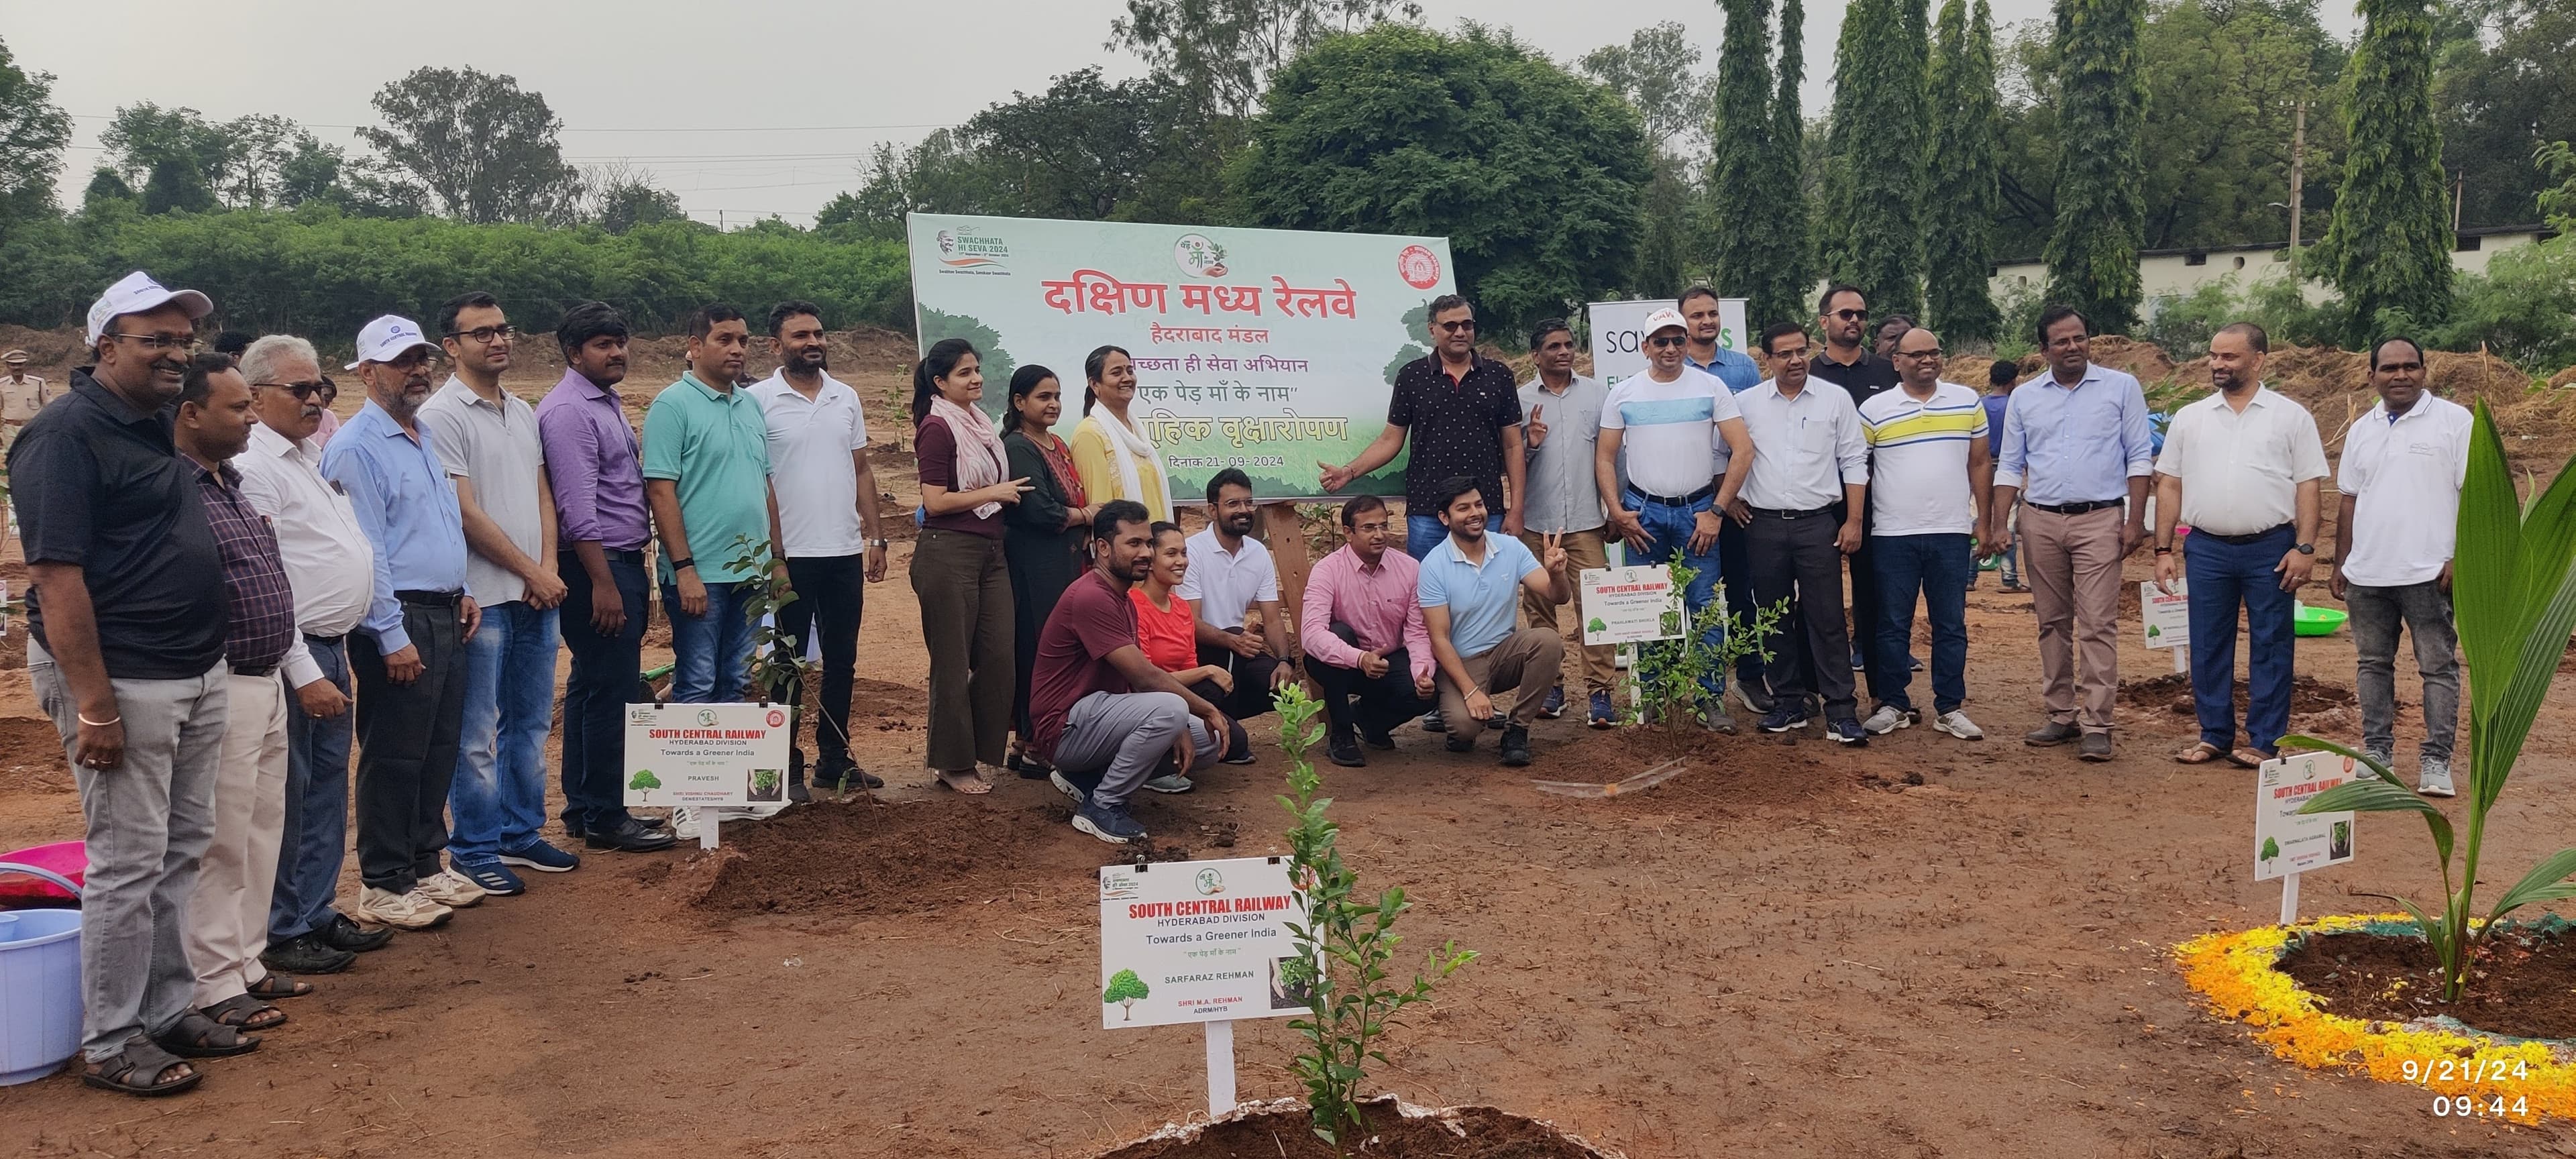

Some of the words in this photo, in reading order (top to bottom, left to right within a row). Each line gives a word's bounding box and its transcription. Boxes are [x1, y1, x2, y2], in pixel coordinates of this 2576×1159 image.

[957, 236, 1004, 245] SWACHHATA
[1040, 269, 1169, 316] दक्षिण
[1179, 284, 1263, 317] मध्य
[1271, 276, 1357, 319] रेलवे
[1150, 322, 1222, 345] हैदराबाद
[1227, 325, 1269, 344] मंडल
[1184, 353, 1201, 374] ही
[1205, 353, 1238, 372] सेवा
[1243, 354, 1309, 373] अभियान
[1174, 380, 1202, 406] पेड़
[1207, 380, 1228, 402] माँ
[1232, 380, 1251, 402] के
[1218, 407, 1348, 448] वृक्षारोपण
[1169, 455, 1203, 467] दिनांक
[1253, 456, 1284, 467] 2024
[1596, 586, 1615, 594] SOUTH
[1617, 584, 1642, 593] CENTRAL
[1642, 582, 1668, 591] RAILWAY
[649, 729, 680, 738] SOUTH
[683, 729, 722, 739] CENTRAL
[725, 729, 767, 739] RAILWAY
[2273, 786, 2292, 799] SOUTH
[2294, 781, 2317, 795] CENTRAL
[1129, 902, 1173, 919] SOUTH
[1176, 899, 1232, 916] CENTRAL
[1234, 895, 1291, 912] RAILWAY
[1158, 916, 1220, 927] HYDERABAD
[1223, 913, 1265, 923] DIVISION
[1146, 933, 1193, 944] Towards
[1205, 930, 1248, 940] Greener
[1251, 928, 1277, 938] India
[1165, 973, 1214, 984] SARFARAZ
[1216, 971, 1254, 980] REHMAN
[1213, 996, 1243, 1004] REHMAN
[1193, 1005, 1228, 1014] ADRM/HYB
